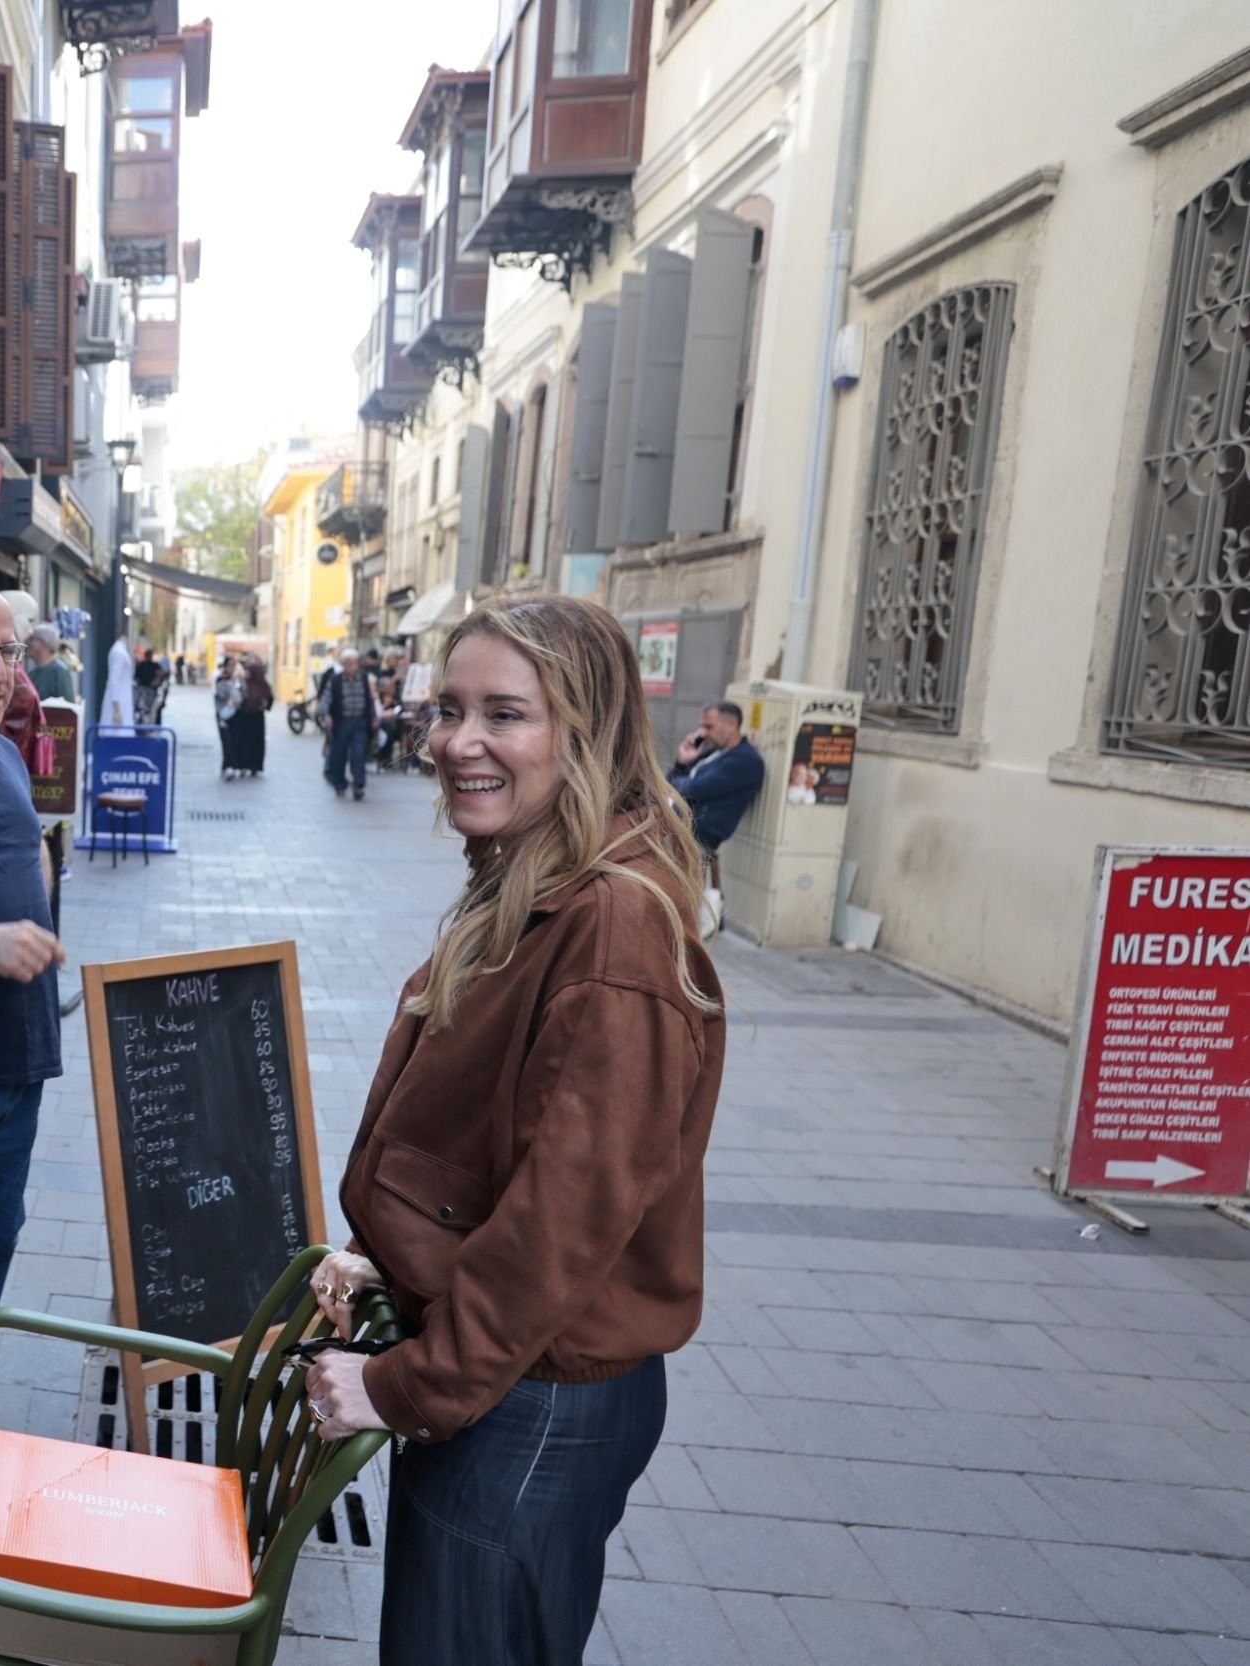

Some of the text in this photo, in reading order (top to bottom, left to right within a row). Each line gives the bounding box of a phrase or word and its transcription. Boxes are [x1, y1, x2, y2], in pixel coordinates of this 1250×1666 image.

[1129, 876, 1250, 911] FURES
[166, 973, 219, 1008] KAHVE
[251, 999, 269, 1020] 60
[256, 1041, 272, 1057] 60
[125, 1062, 180, 1083] Espresso
[42, 1487, 168, 1517] LUMBERJACK
